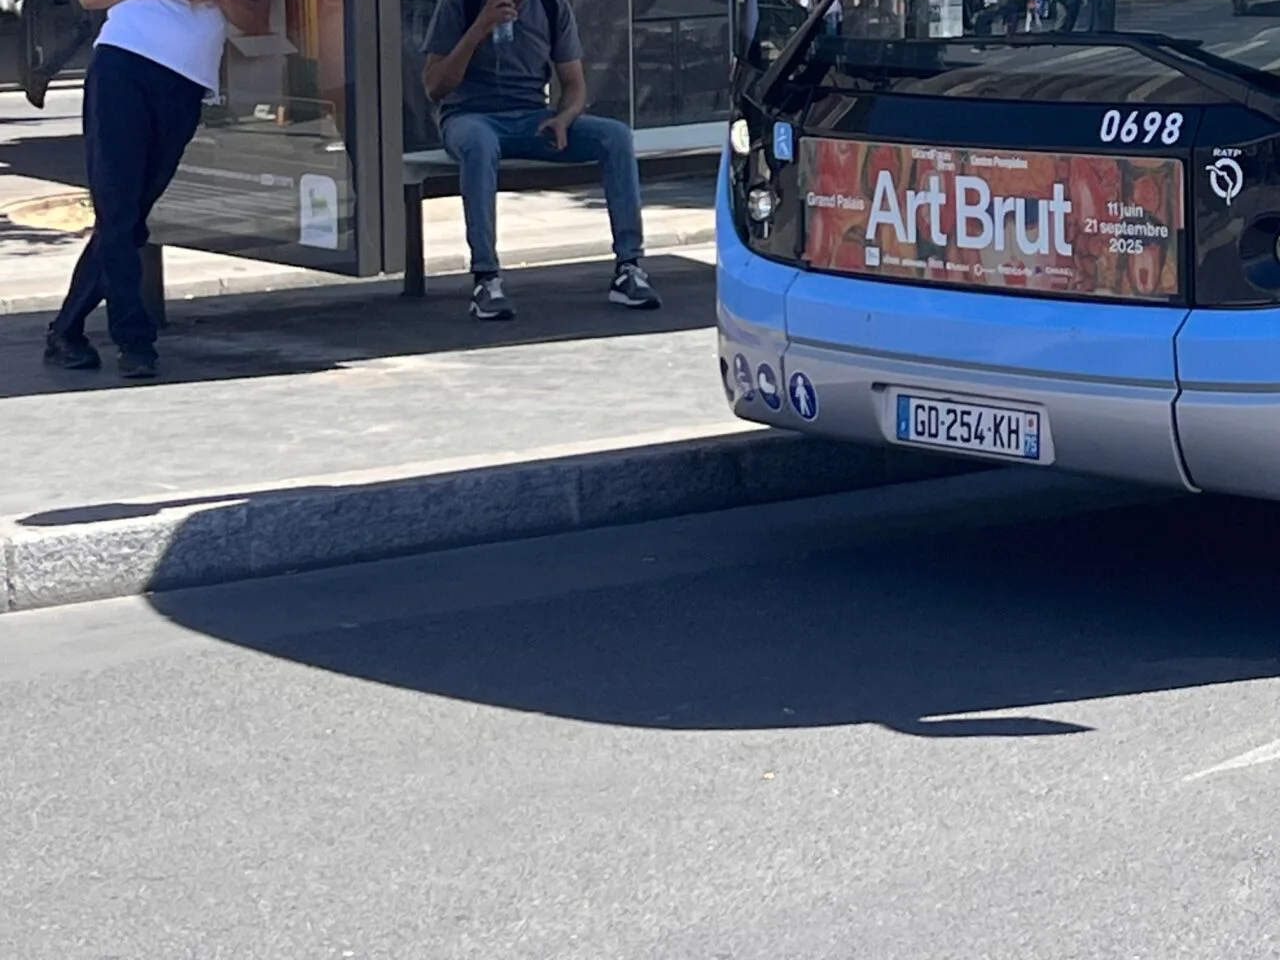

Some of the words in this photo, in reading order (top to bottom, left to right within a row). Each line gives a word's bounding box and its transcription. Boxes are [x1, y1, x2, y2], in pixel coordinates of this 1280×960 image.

[1100, 109, 1184, 145] 0698
[1212, 147, 1242, 158] RATP
[807, 191, 836, 208] Grand
[836, 194, 865, 211] Palais
[1107, 201, 1119, 217] 11
[1119, 204, 1144, 220] juin
[865, 170, 948, 247] Art
[956, 175, 1073, 256] Brut
[1083, 218, 1099, 234] 21
[1100, 220, 1169, 238] septembre
[1108, 239, 1144, 254] 2025
[914, 404, 1020, 451] GD-254-KH
